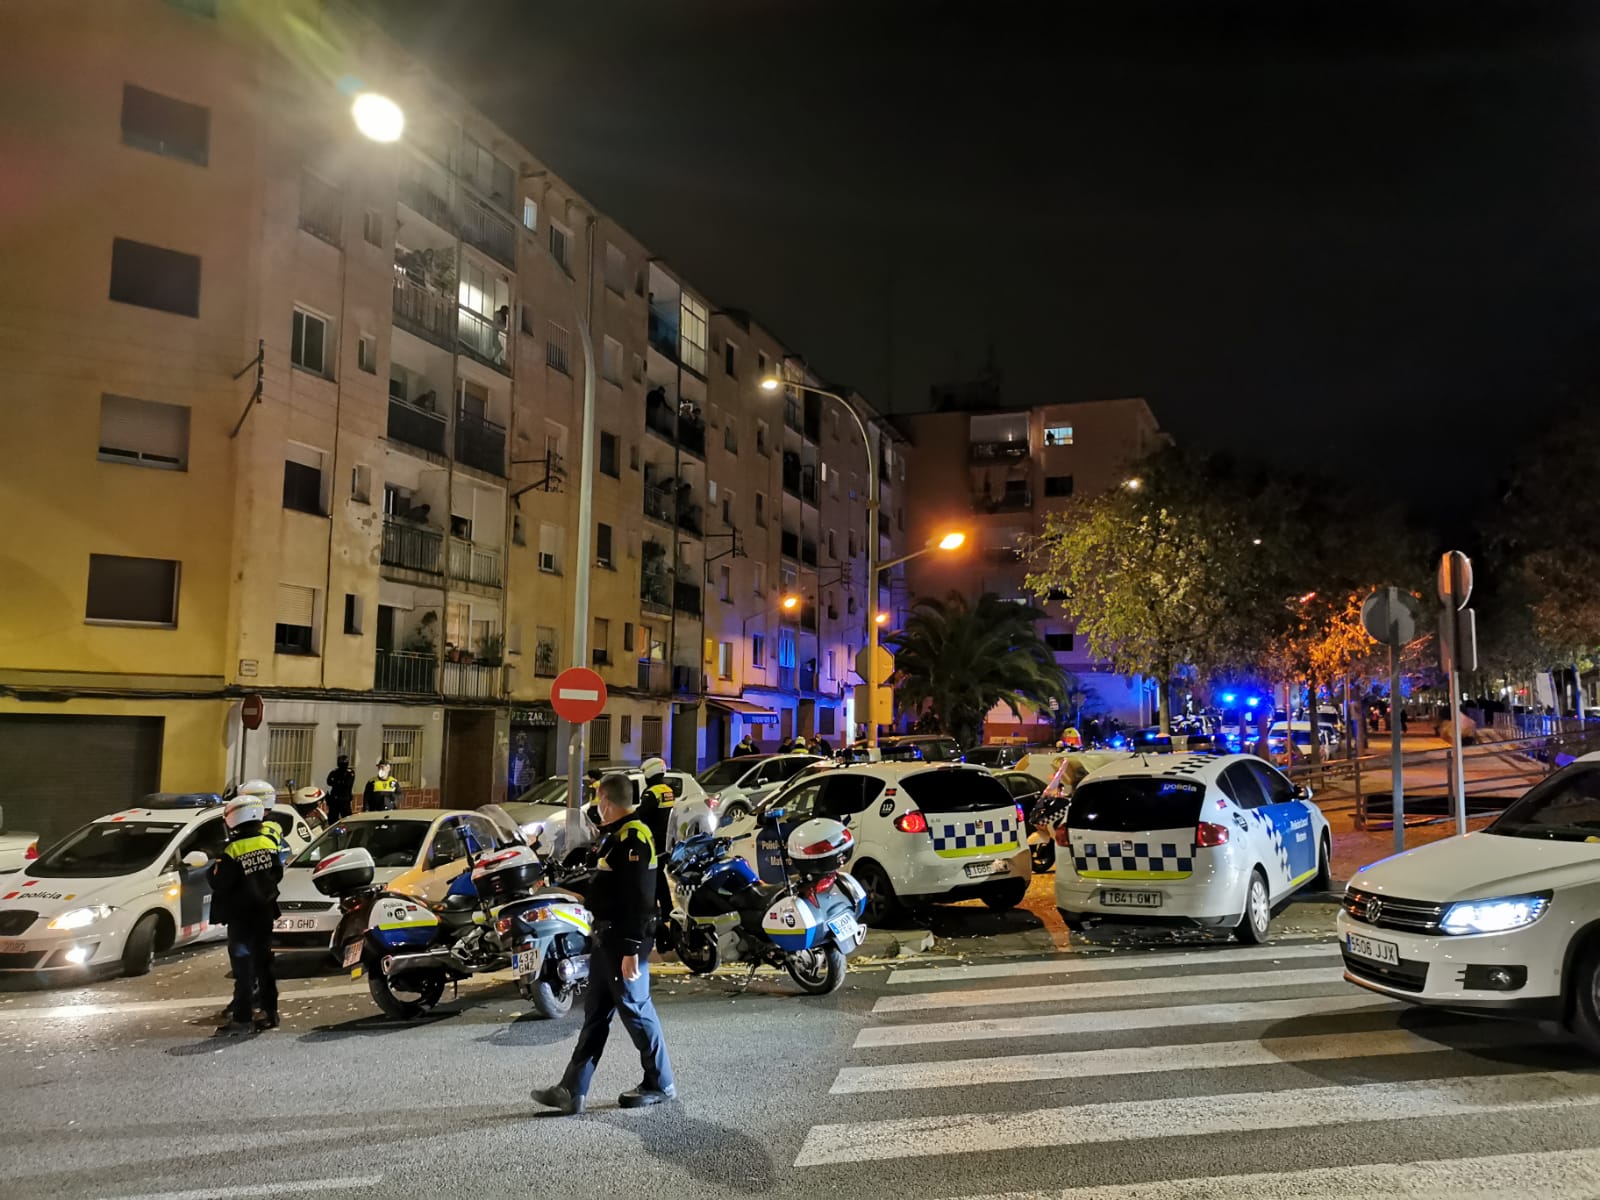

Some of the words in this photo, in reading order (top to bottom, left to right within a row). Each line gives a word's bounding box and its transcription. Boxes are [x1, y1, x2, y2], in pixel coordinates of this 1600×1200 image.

[1108, 892, 1134, 904] 1641
[296, 919, 315, 929] GHD
[519, 950, 538, 963] 4321
[1375, 943, 1397, 963] JJX
